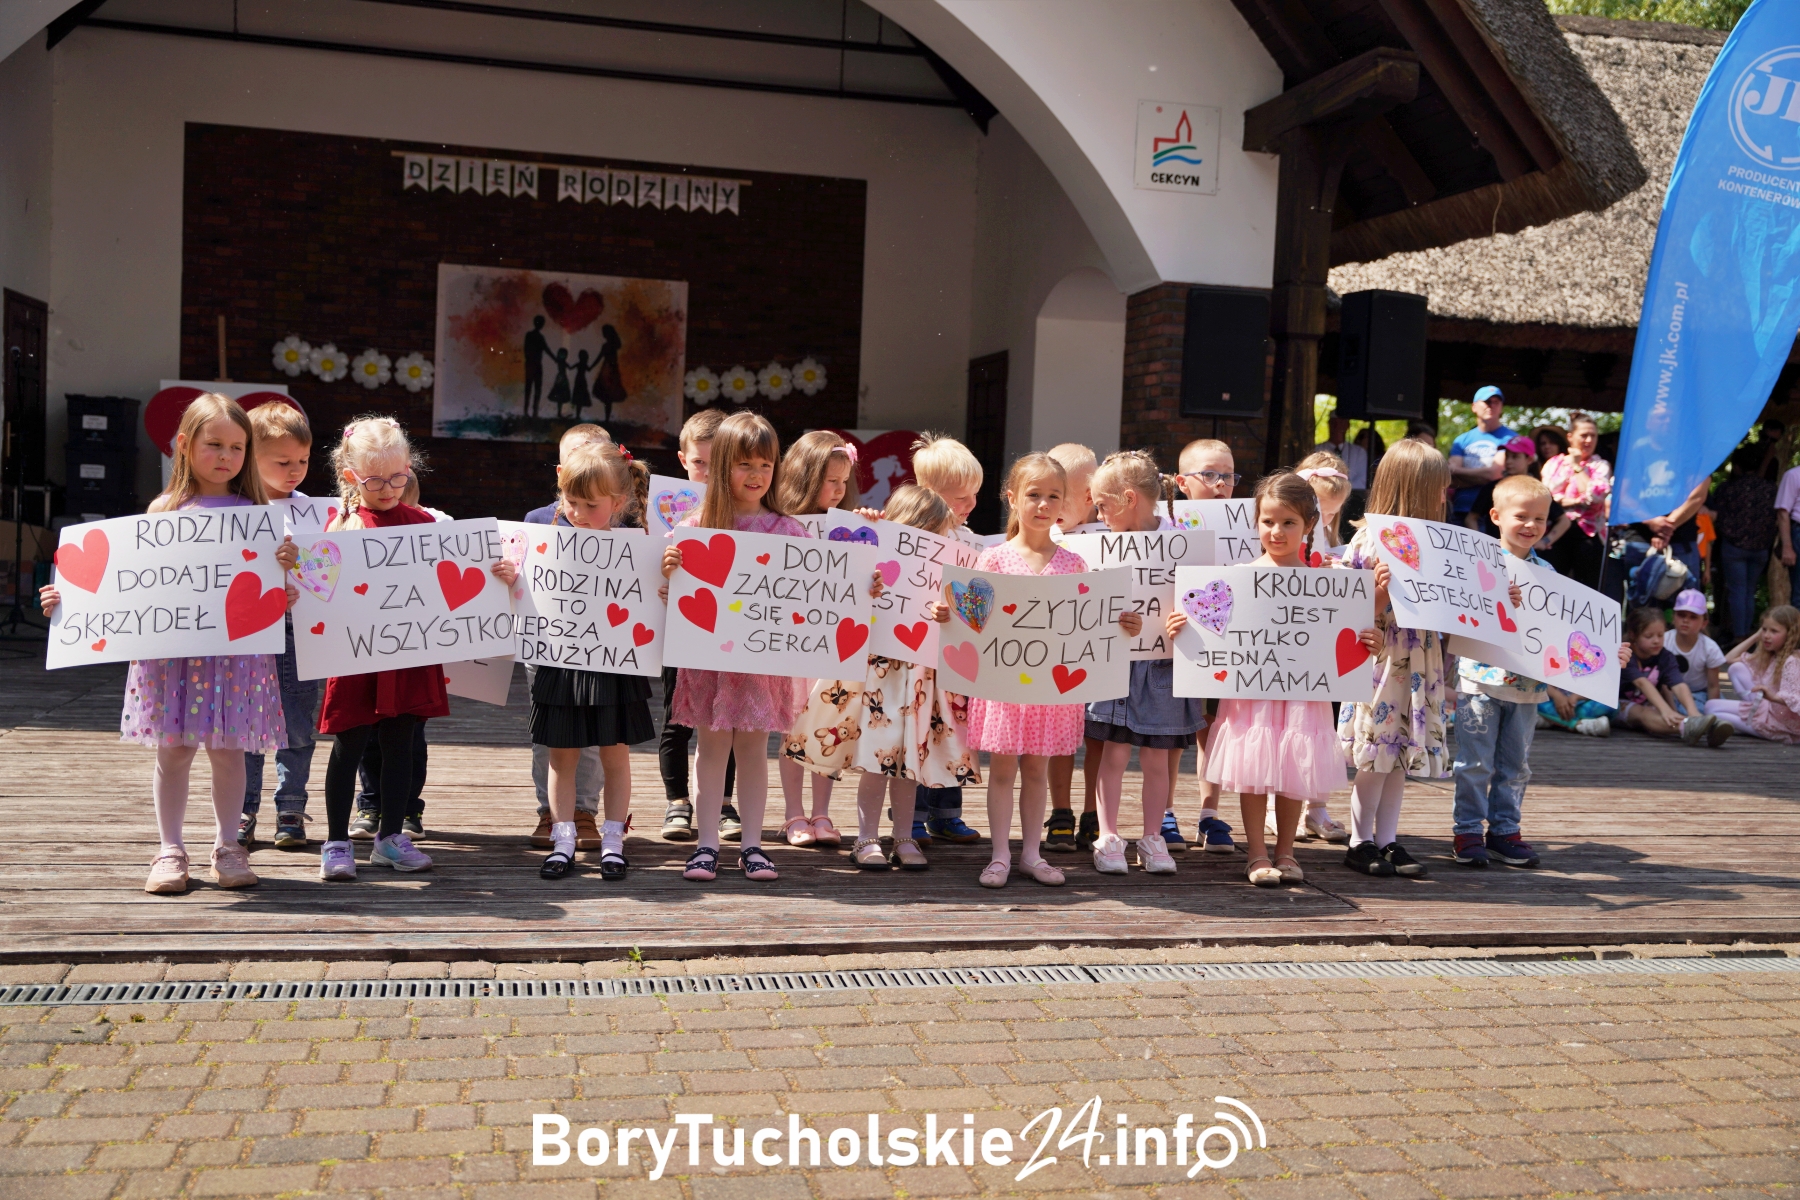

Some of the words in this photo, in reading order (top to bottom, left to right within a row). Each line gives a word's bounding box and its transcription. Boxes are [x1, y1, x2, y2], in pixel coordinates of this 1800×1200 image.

[1744, 74, 1800, 124] J
[408, 160, 535, 190] DZIEŃ
[563, 174, 736, 204] RODZINY
[1151, 172, 1200, 187] CEKCYN
[1727, 165, 1800, 193] PRODUCENT
[1652, 281, 1689, 415] www.jk.com.pl
[135, 510, 278, 551] RODZINA
[555, 530, 636, 572] MOJA
[783, 542, 849, 579] DOM
[895, 531, 943, 566] BEZ
[1101, 533, 1188, 564] MAMO
[1426, 525, 1507, 577] DZIĘKUJĘ
[117, 562, 234, 594] DODAJE
[532, 564, 643, 603] RODZINA
[1131, 562, 1176, 586] TEŚ
[1254, 568, 1368, 600] KRÓLOWA
[1443, 560, 1468, 581] ŻE
[379, 584, 426, 612] ZA
[732, 573, 858, 606] ZACZYNA
[872, 591, 912, 614] ST
[1403, 579, 1495, 616] JESTEŚCIE
[552, 597, 588, 616] TO
[743, 602, 783, 626] SIĘ
[806, 607, 840, 627] OD
[1012, 595, 1125, 636] ŻYJCIE
[1271, 605, 1340, 625] JEST
[60, 604, 217, 646] SKRZYDEŁ
[346, 612, 512, 660] WSZYSTKO
[512, 613, 600, 642] LEPSZA
[743, 628, 830, 654] SERCA
[1228, 628, 1311, 647] TYLKO
[521, 637, 640, 670] DRUŻYNA
[983, 636, 1049, 668] 100
[1060, 634, 1118, 665] LAT
[1197, 648, 1281, 668] JEDNA
[1236, 668, 1331, 693] MAMA
